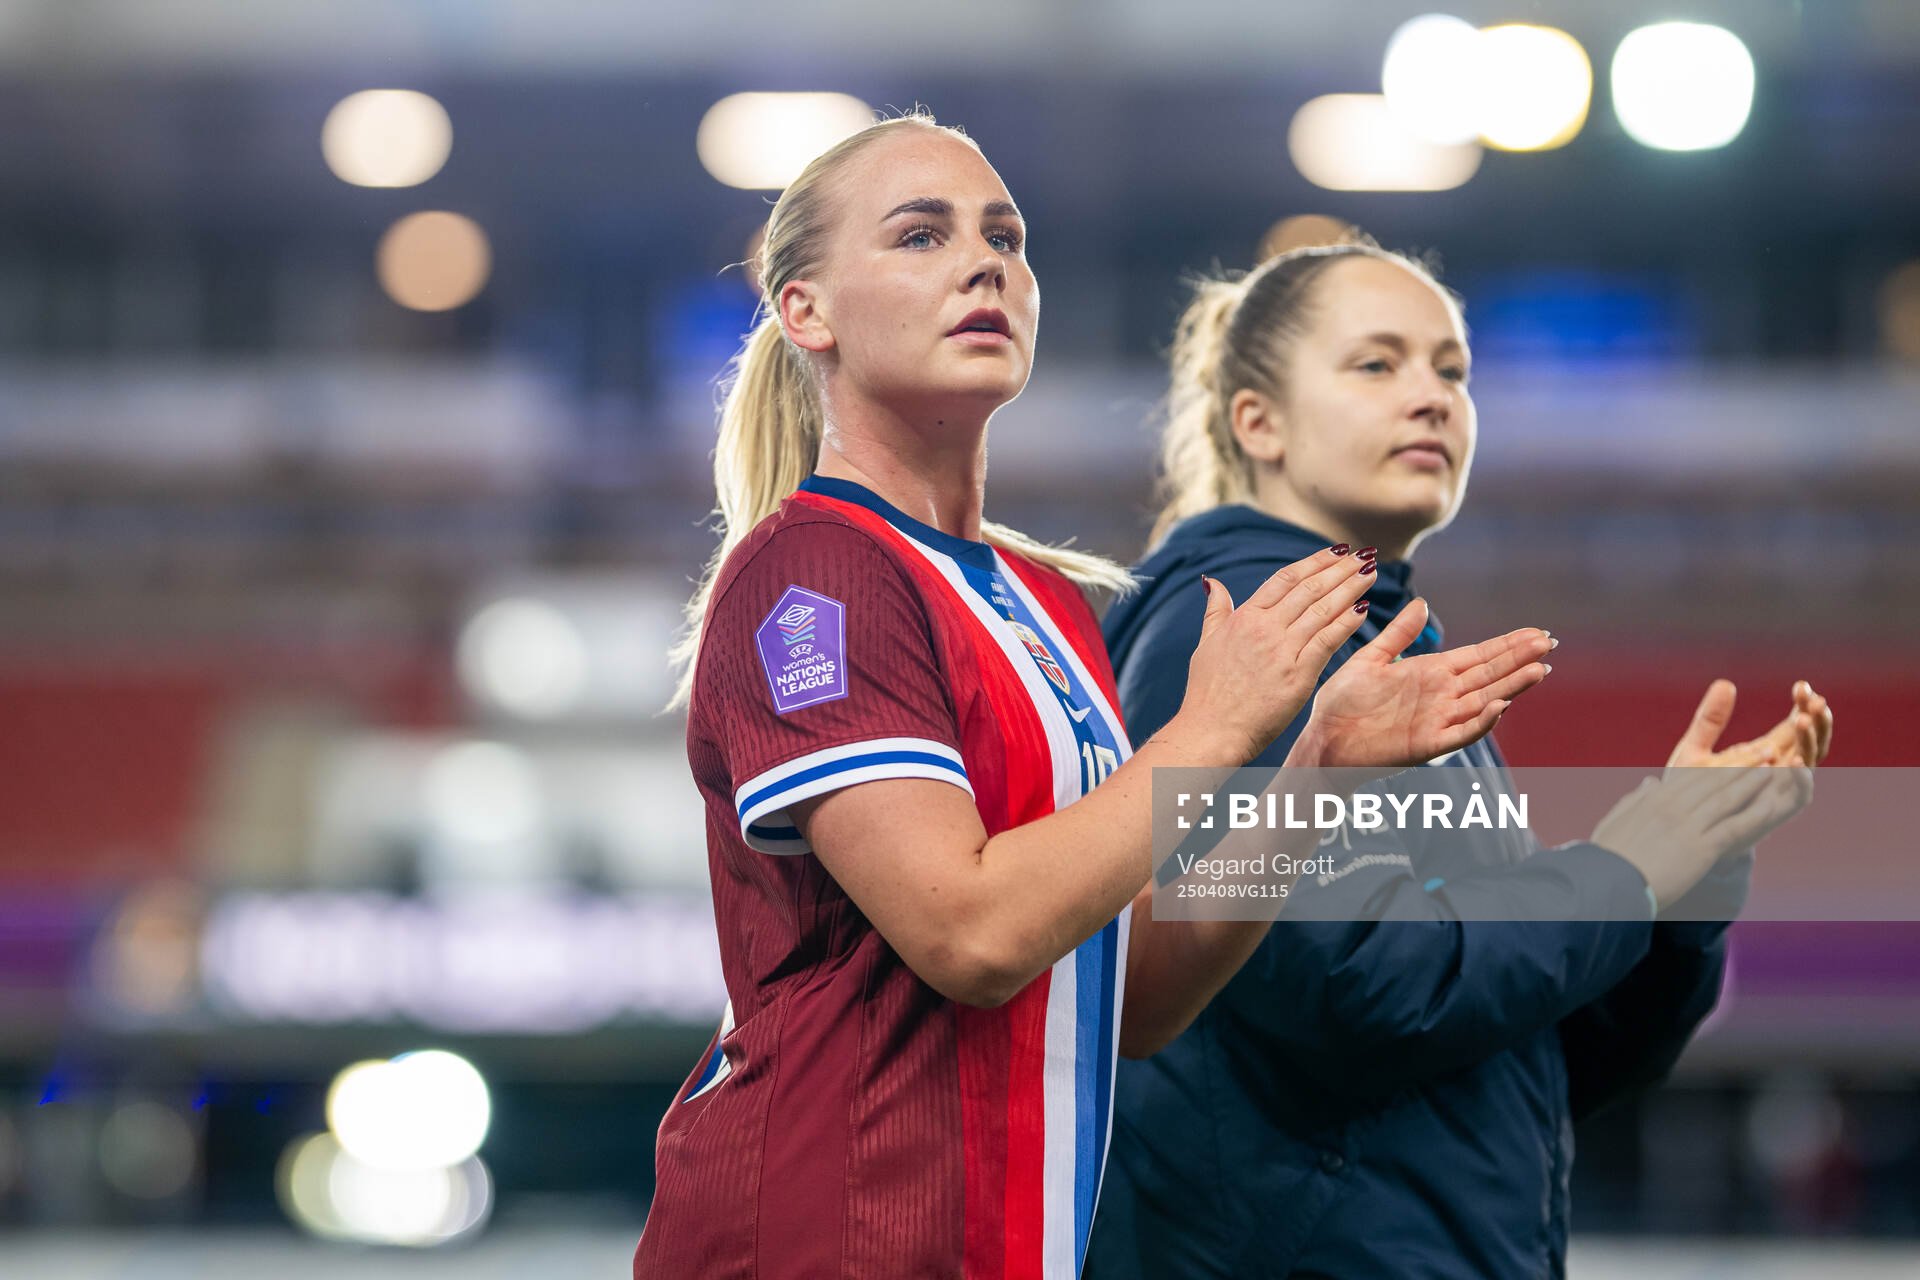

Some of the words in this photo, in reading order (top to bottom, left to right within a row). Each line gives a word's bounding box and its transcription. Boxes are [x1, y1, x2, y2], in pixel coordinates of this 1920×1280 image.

[782, 652, 826, 672] women's
[789, 643, 814, 659] UEFA
[776, 661, 836, 687] NATIONS
[781, 673, 835, 697] LEAGUE
